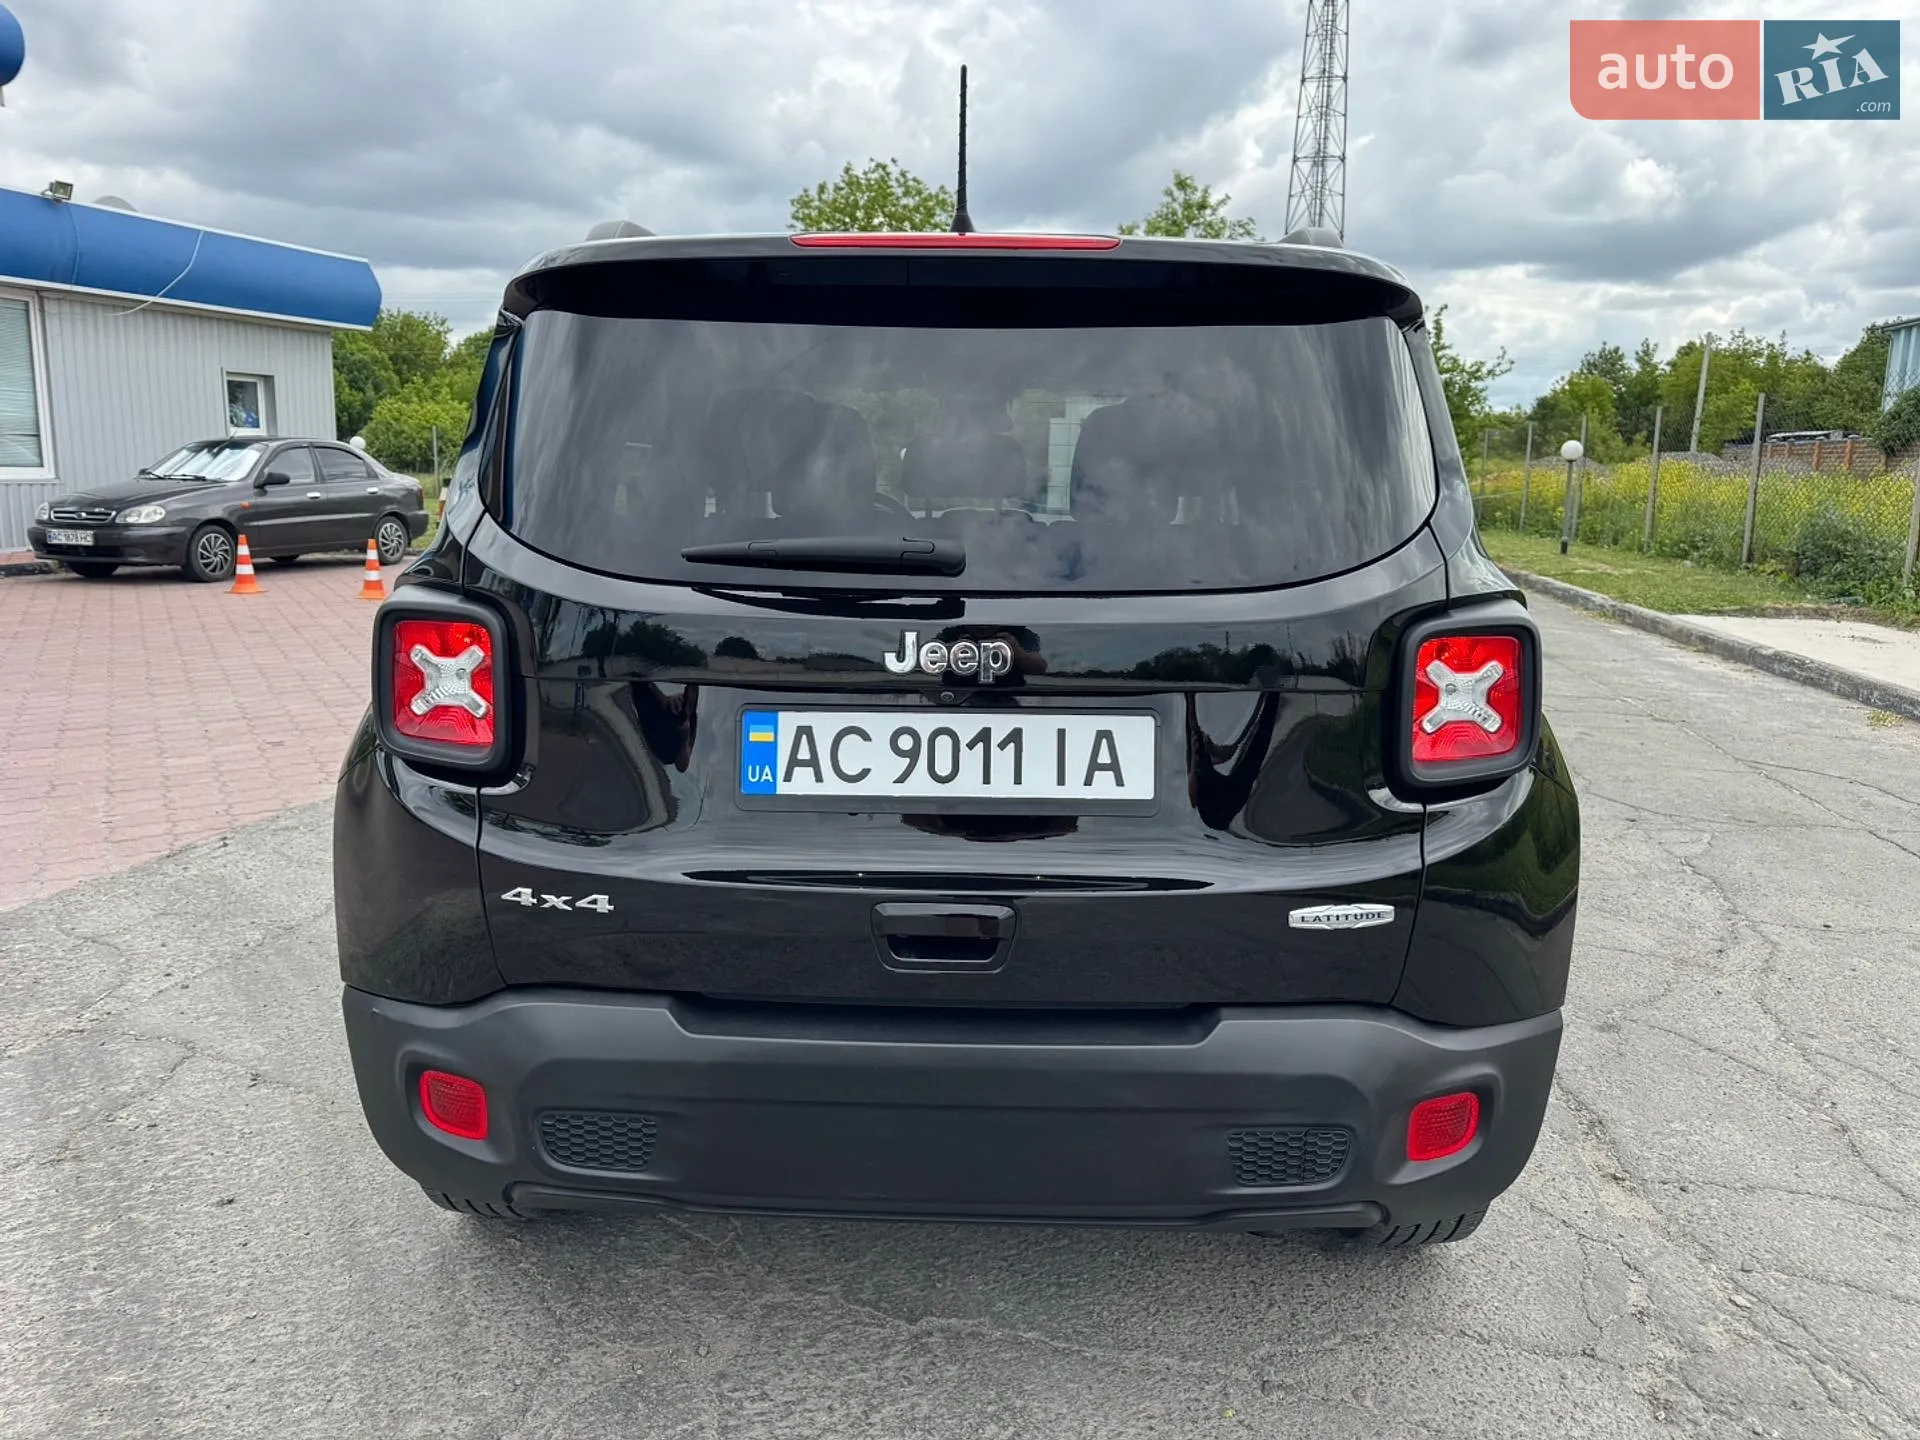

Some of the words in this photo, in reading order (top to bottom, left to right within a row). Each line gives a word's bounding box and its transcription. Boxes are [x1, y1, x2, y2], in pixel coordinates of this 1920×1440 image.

[883, 631, 1014, 684] Jeep
[748, 765, 774, 782] UA
[783, 725, 873, 784] AC
[889, 726, 1024, 786] 9011
[1056, 728, 1126, 787] IA
[1300, 911, 1386, 923] LATITUDE
